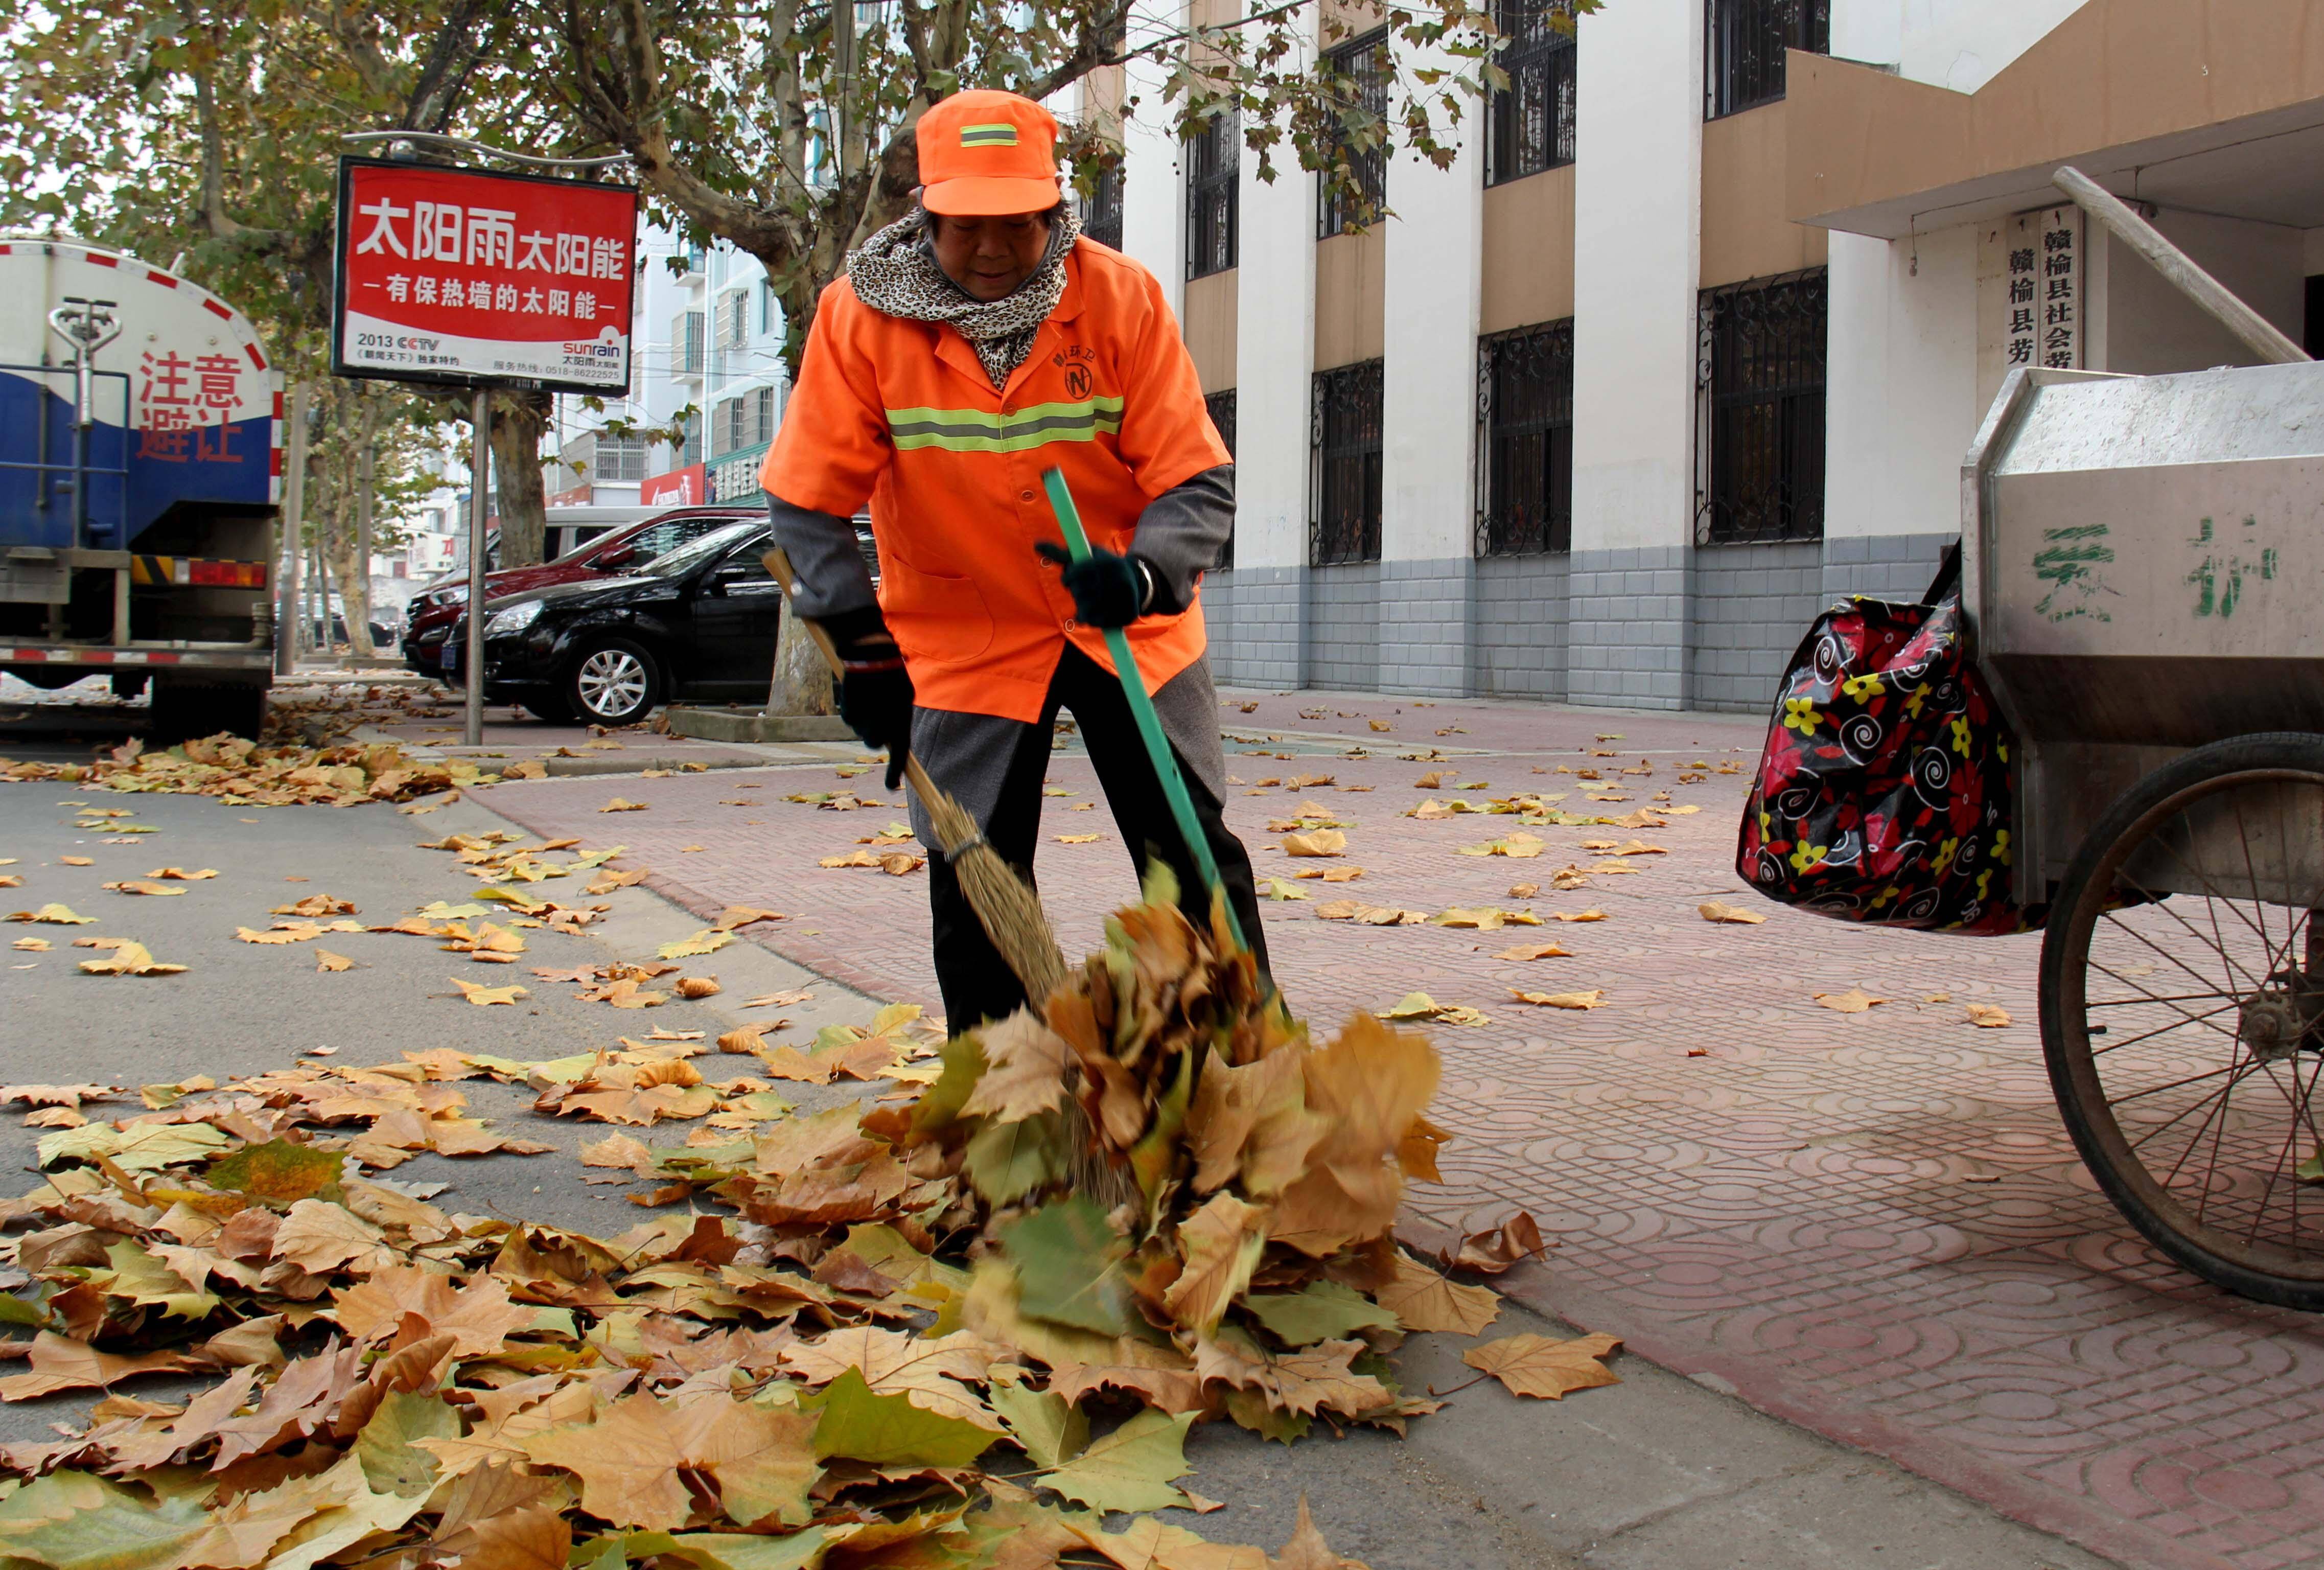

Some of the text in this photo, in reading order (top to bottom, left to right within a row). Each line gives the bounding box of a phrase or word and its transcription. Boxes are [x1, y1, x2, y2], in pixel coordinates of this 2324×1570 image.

[2009, 248, 2035, 364] 赣榆县劳
[358, 333, 439, 350] 2013 CCTV
[564, 339, 620, 357] sunrain
[140, 351, 243, 407] 注意
[136, 408, 243, 463] 避让
